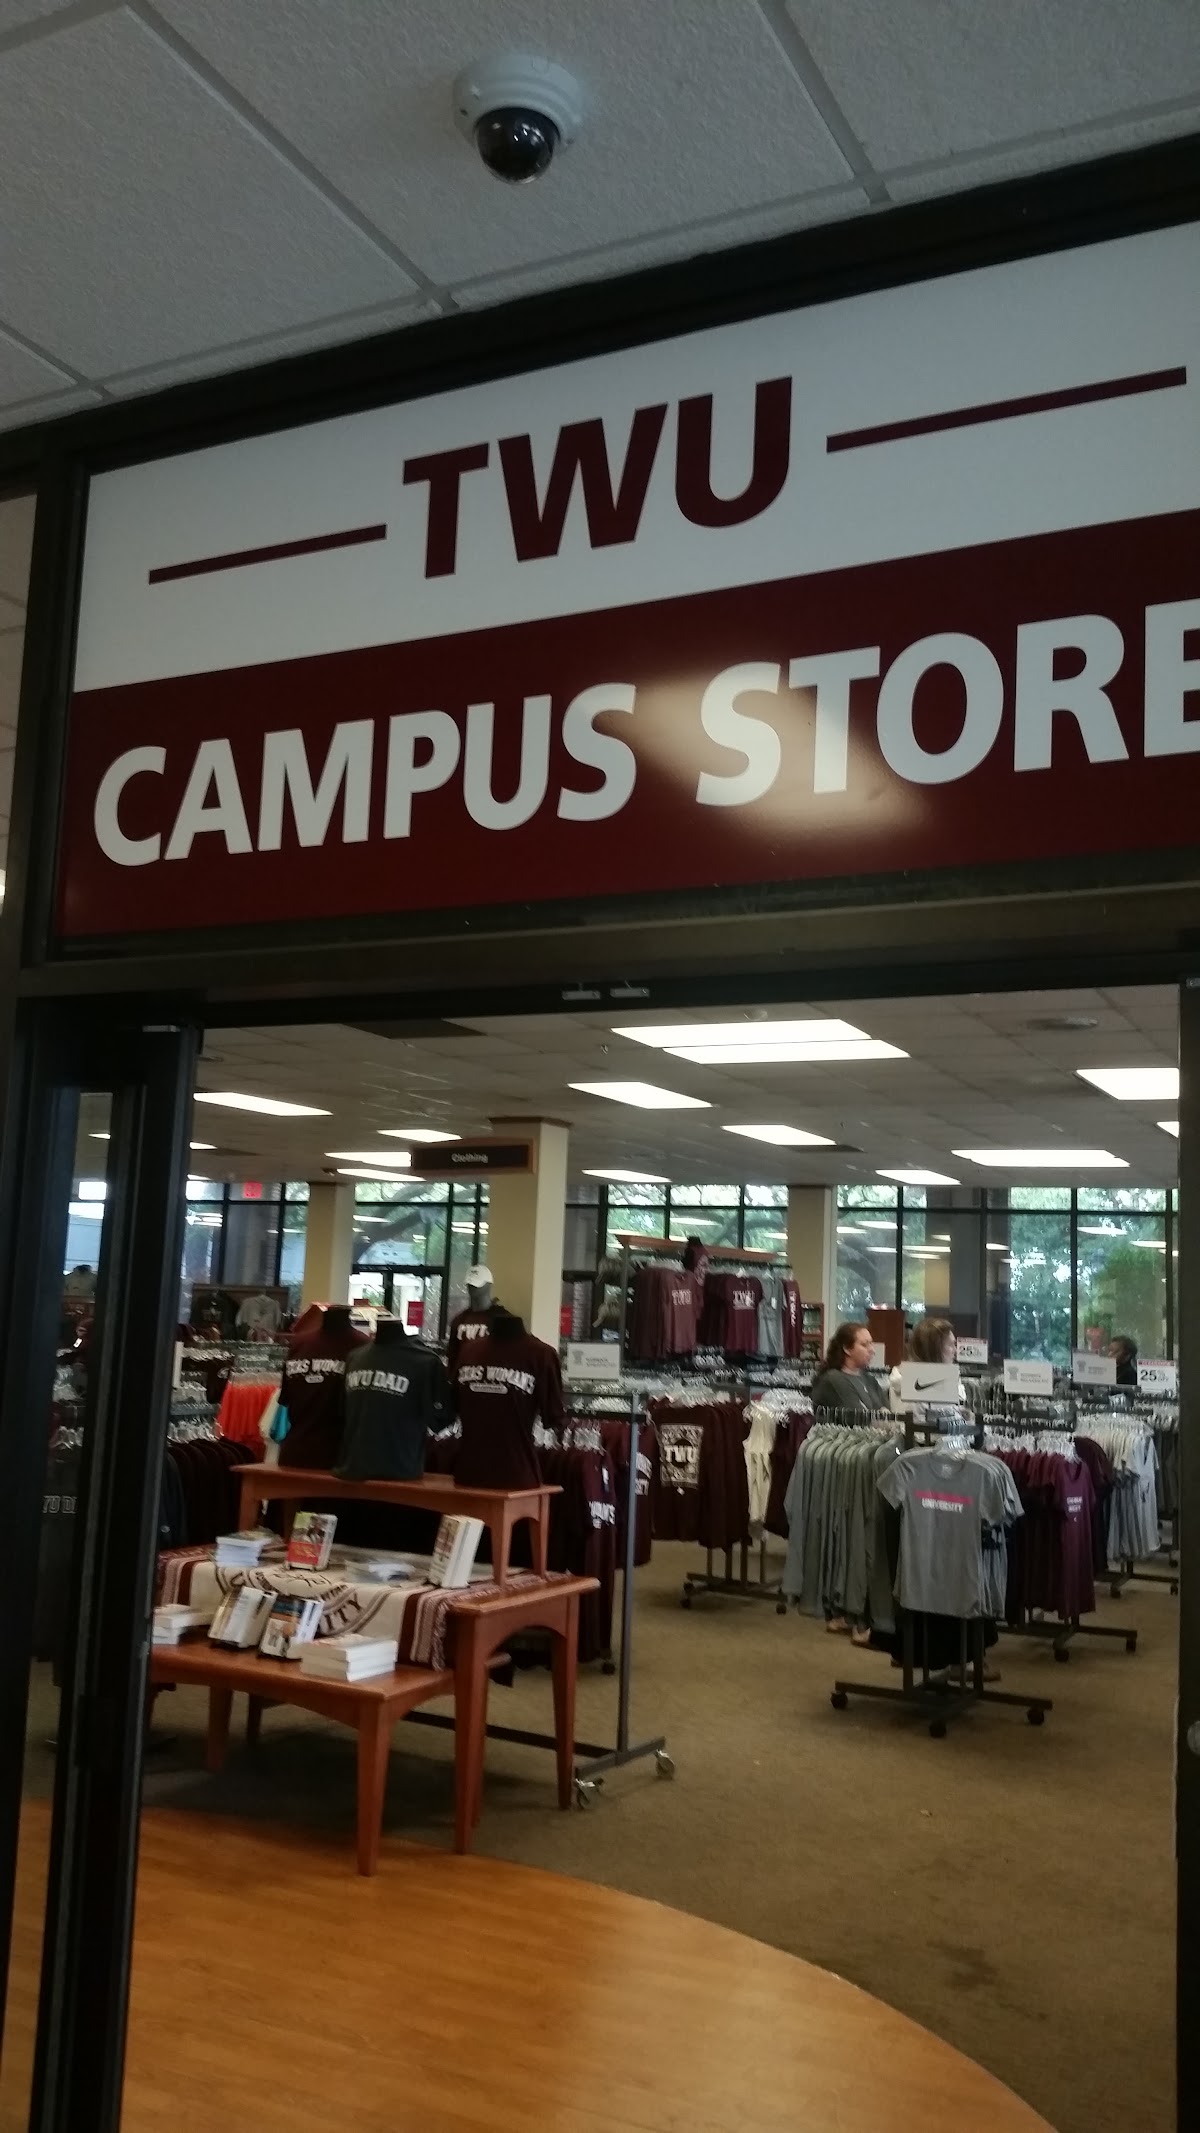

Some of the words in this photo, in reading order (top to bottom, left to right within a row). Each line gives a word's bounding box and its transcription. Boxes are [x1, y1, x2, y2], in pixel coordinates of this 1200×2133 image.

[402, 376, 793, 579] TWU
[93, 683, 637, 867] CAMPUS
[695, 598, 1200, 807] STORE
[451, 1152, 489, 1164] Clothing
[372, 1369, 410, 1394] DAD
[1140, 1369, 1157, 1382] 25
[663, 1445, 698, 1463] TWU
[921, 1497, 964, 1514] UNIVERSITY
